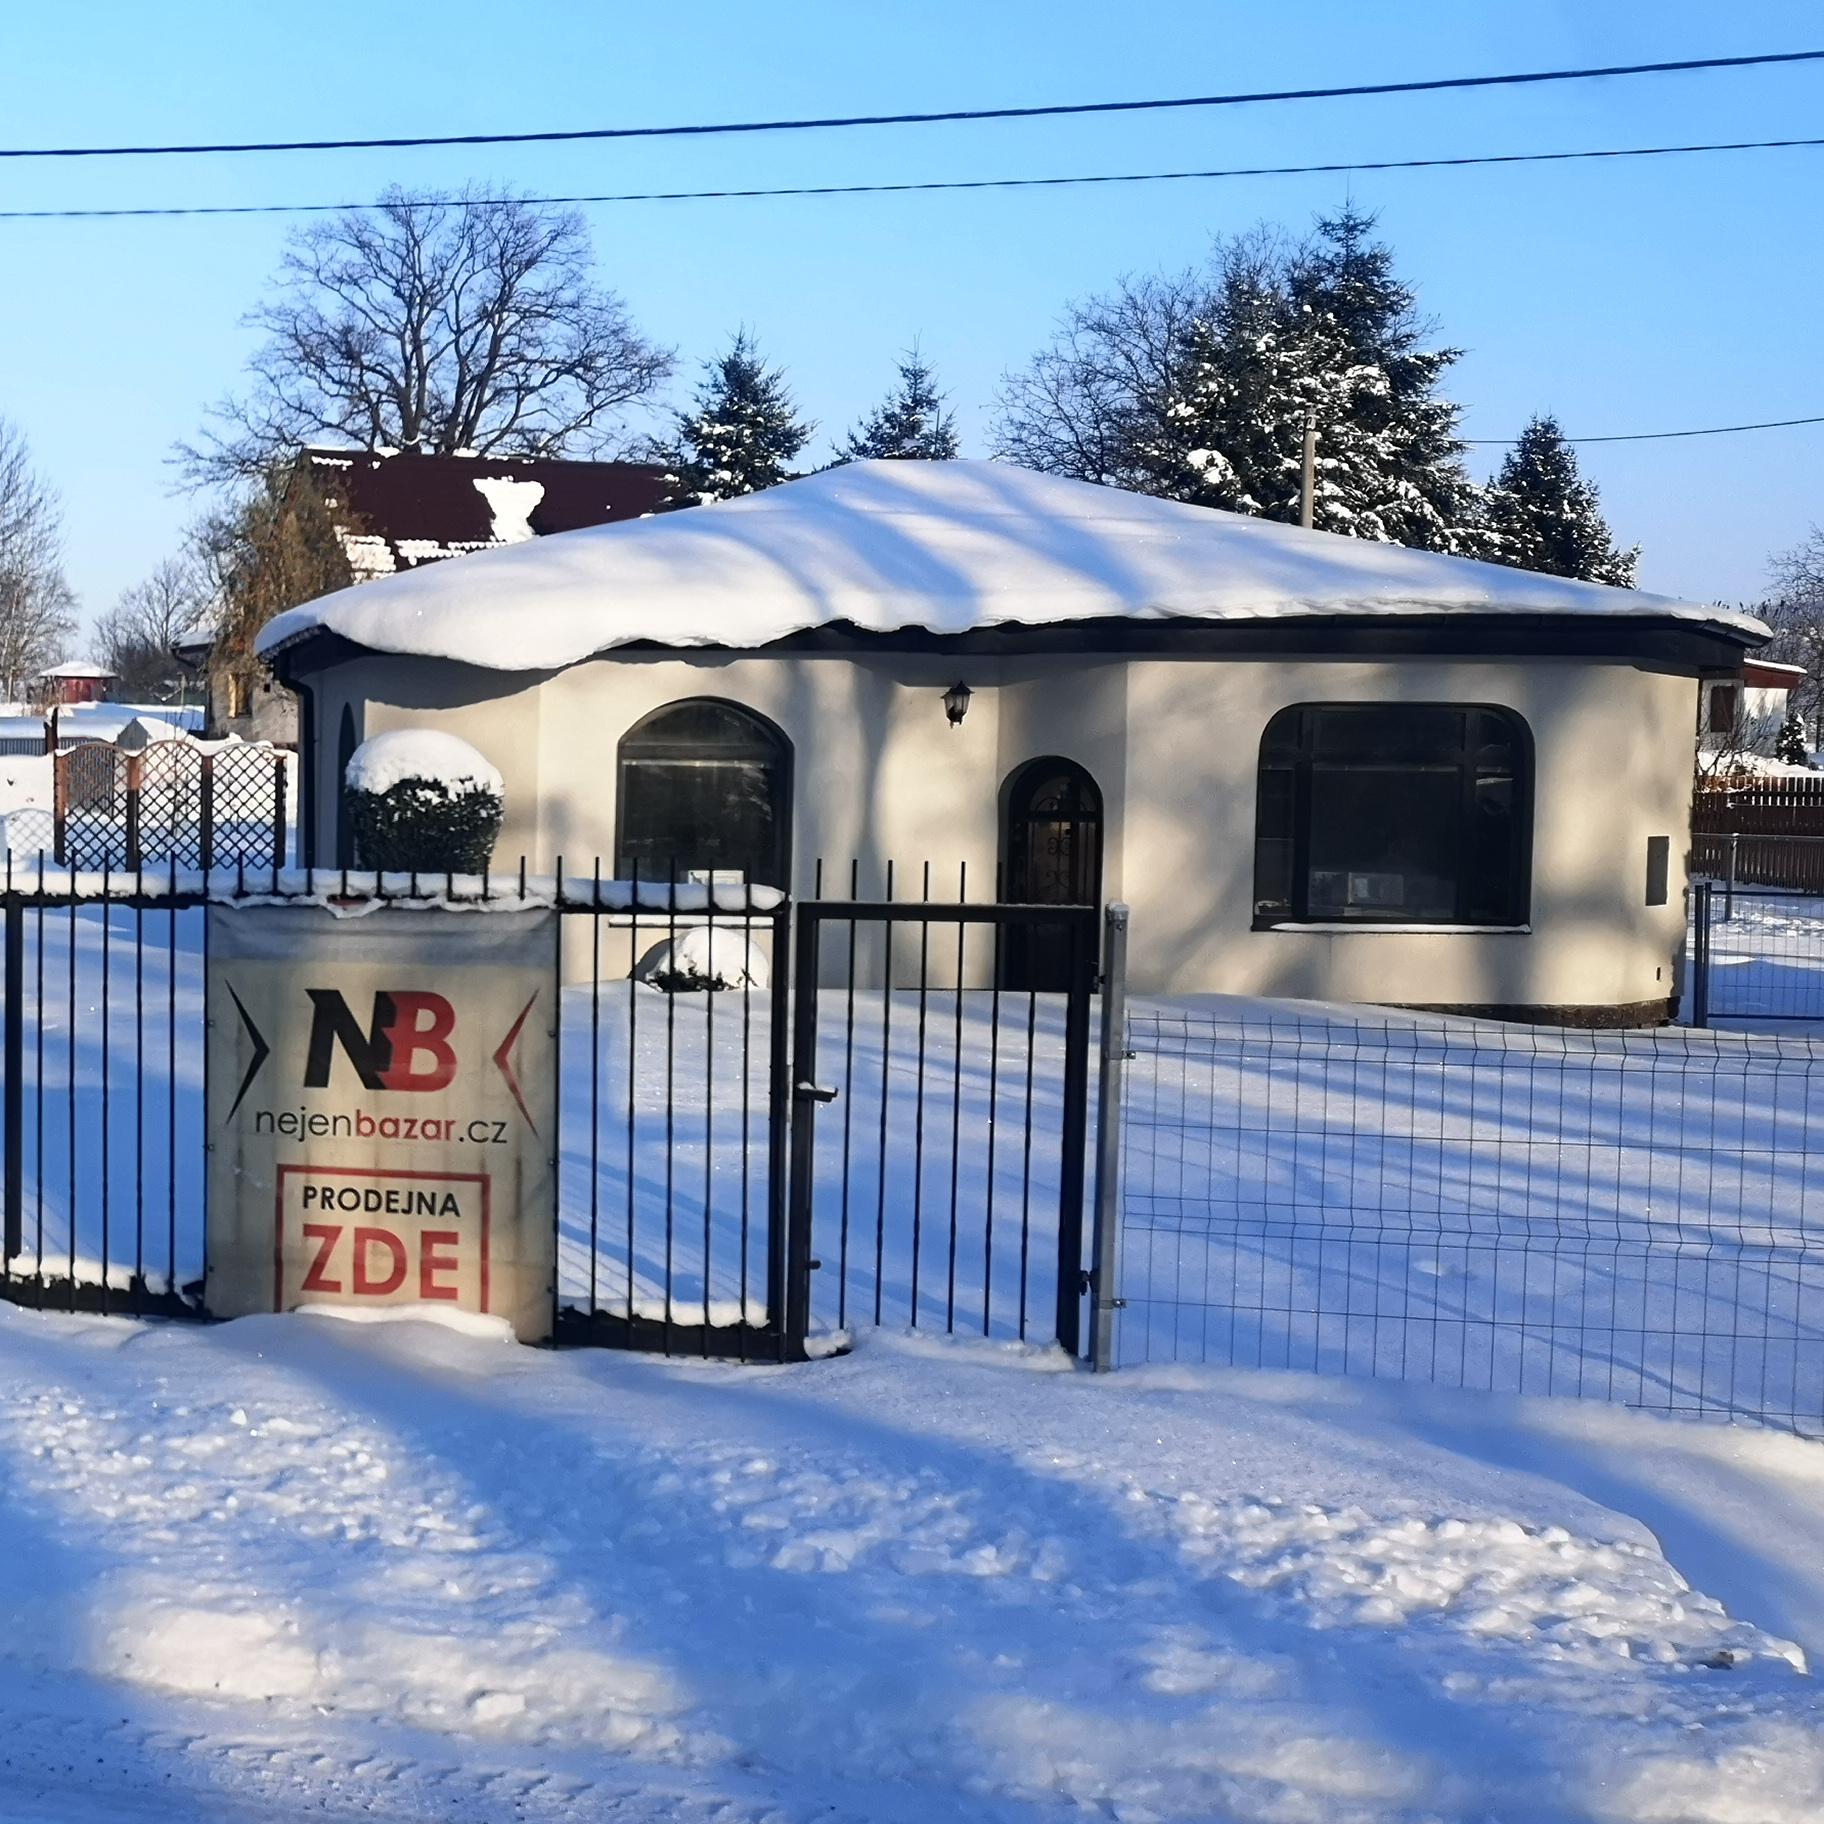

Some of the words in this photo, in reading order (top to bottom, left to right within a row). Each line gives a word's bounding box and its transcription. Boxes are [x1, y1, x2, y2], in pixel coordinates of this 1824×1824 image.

[304, 988, 458, 1092] NB
[255, 1106, 508, 1144] nejenbazar.cz
[302, 1186, 461, 1218] PRODEJNA
[301, 1223, 459, 1301] ZDE
